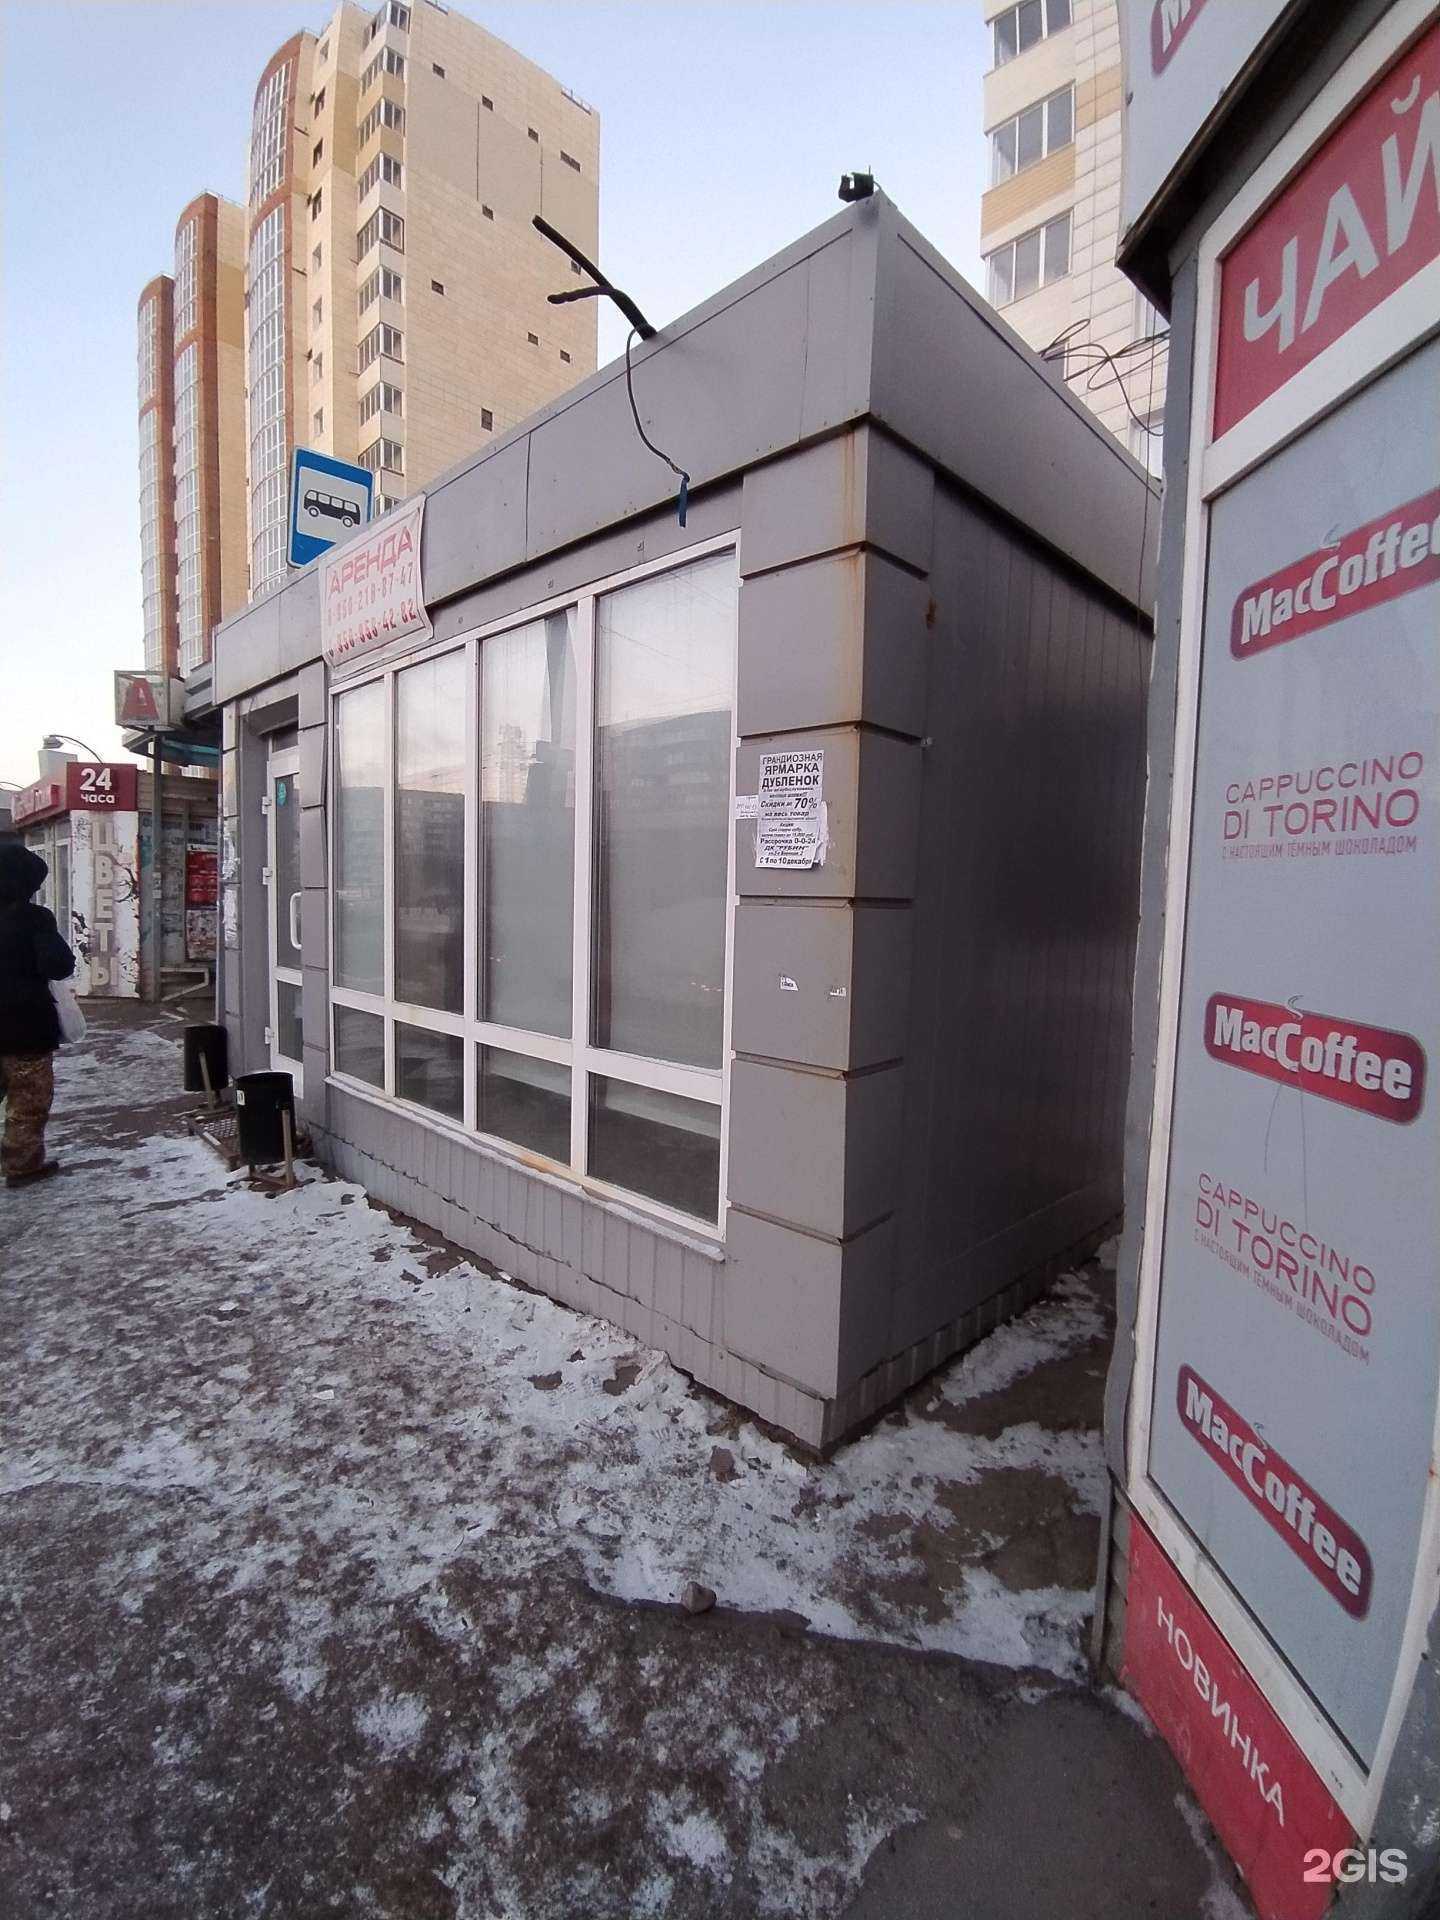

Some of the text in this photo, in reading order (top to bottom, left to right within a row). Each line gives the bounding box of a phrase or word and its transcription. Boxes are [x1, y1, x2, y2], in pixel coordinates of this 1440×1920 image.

[1244, 75, 1440, 354] ЧАЙ
[328, 526, 413, 598] АРЕНДА
[80, 767, 112, 791] 24
[761, 775, 819, 790] ДУБЛЕНОК
[762, 752, 823, 765] ГРАНДИОЗНАЯ
[764, 762, 820, 776] ЯРМАРКА
[1226, 751, 1424, 804] CAPPUCCINO
[80, 792, 116, 804] часа
[760, 800, 785, 808] Скидки
[794, 797, 818, 810] 70%
[789, 810, 810, 818] товар
[1223, 788, 1420, 840] DI TORINO
[778, 856, 787, 864] 10
[1335, 835, 1417, 856] ШОКОЛАДОМ
[91, 821, 119, 986] ЦВЕТЫ
[1213, 1004, 1413, 1099] MacCoffee
[1199, 1173, 1376, 1295] CAPPUCCINO
[1196, 1197, 1372, 1337] DI TORINO
[1296, 1302, 1371, 1367] ШОКОЛАДОМ
[1185, 1377, 1362, 1596] MacCoffee
[1157, 1596, 1285, 1827] НОВИНКА
